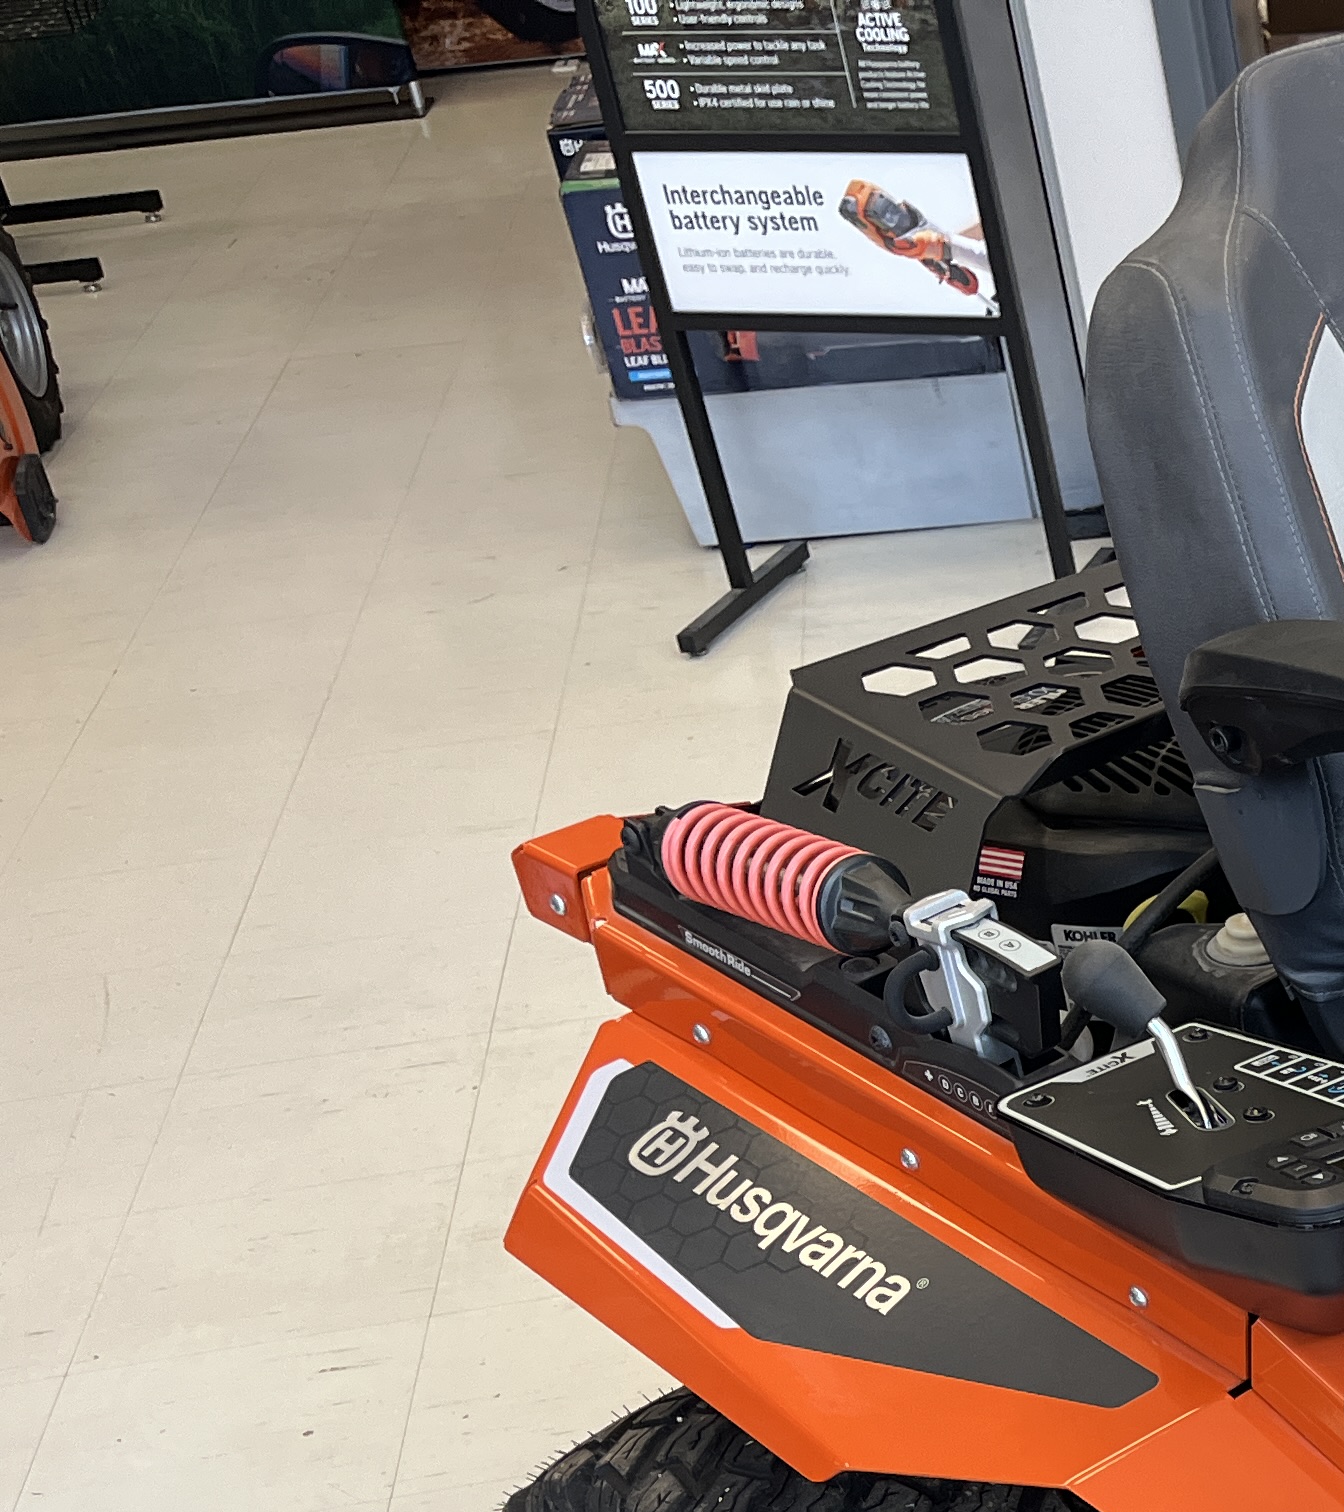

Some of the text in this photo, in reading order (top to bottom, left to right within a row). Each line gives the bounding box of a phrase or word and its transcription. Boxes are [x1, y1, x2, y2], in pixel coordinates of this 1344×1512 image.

[626, 0, 658, 15] 100
[858, 12, 902, 27] ACTIVE
[856, 27, 910, 42] COOLING
[684, 40, 726, 51] Increased
[726, 41, 752, 52] power
[643, 79, 680, 99] 500
[663, 184, 824, 210] Interchangeable
[669, 210, 819, 235] battery system
[678, 247, 731, 258] Lithium-ion
[733, 247, 777, 259] batteries
[779, 250, 795, 259] are
[683, 265, 705, 275] easy
[749, 264, 768, 273] and
[770, 264, 812, 276] recharge
[620, 276, 649, 294] MA
[792, 737, 958, 832] XCITE
[977, 876, 1018, 890] MADE IN USA
[672, 1141, 911, 1316] Husqvarna
